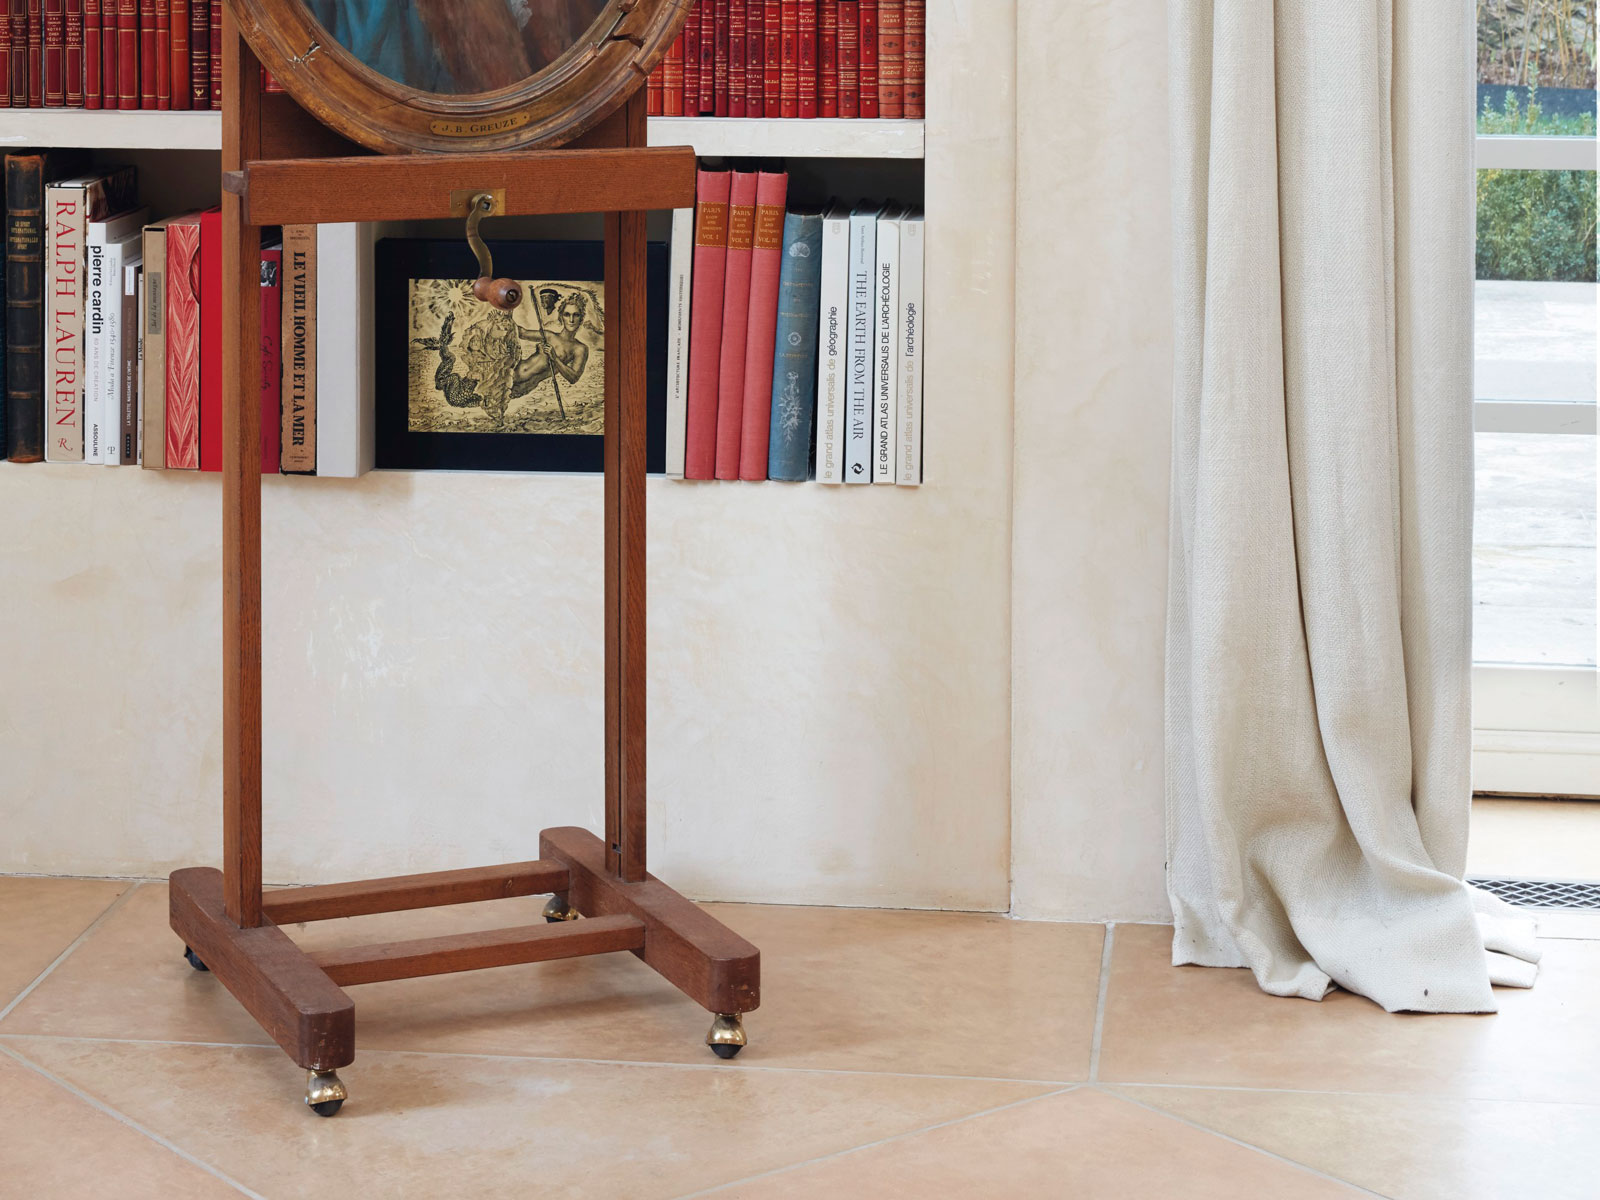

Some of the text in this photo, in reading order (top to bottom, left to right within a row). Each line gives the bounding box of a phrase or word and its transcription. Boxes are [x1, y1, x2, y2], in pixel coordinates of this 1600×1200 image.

[470, 118, 518, 133] GREUZE
[90, 245, 104, 287] pierre
[294, 252, 305, 270] LE
[92, 290, 104, 334] cardin
[294, 272, 306, 313] VIEIL
[880, 263, 890, 330] L'ARCHÉOLOGIE
[56, 200, 76, 428] RALPH LAUREN
[294, 316, 306, 370] HOMME
[853, 271, 867, 440] THE EARTH FROM THE AIR
[882, 331, 889, 344] DE
[93, 361, 99, 370] DE
[293, 373, 305, 392] ET
[881, 346, 889, 401] UNIVERSALIS
[293, 394, 304, 413] LA
[824, 306, 838, 479] le grand atlas universalis de géographie
[904, 303, 916, 480] le grand atlas universalis de l'archéologie
[292, 415, 305, 446] MER
[880, 431, 888, 462] GRAND
[880, 464, 887, 474] LE
